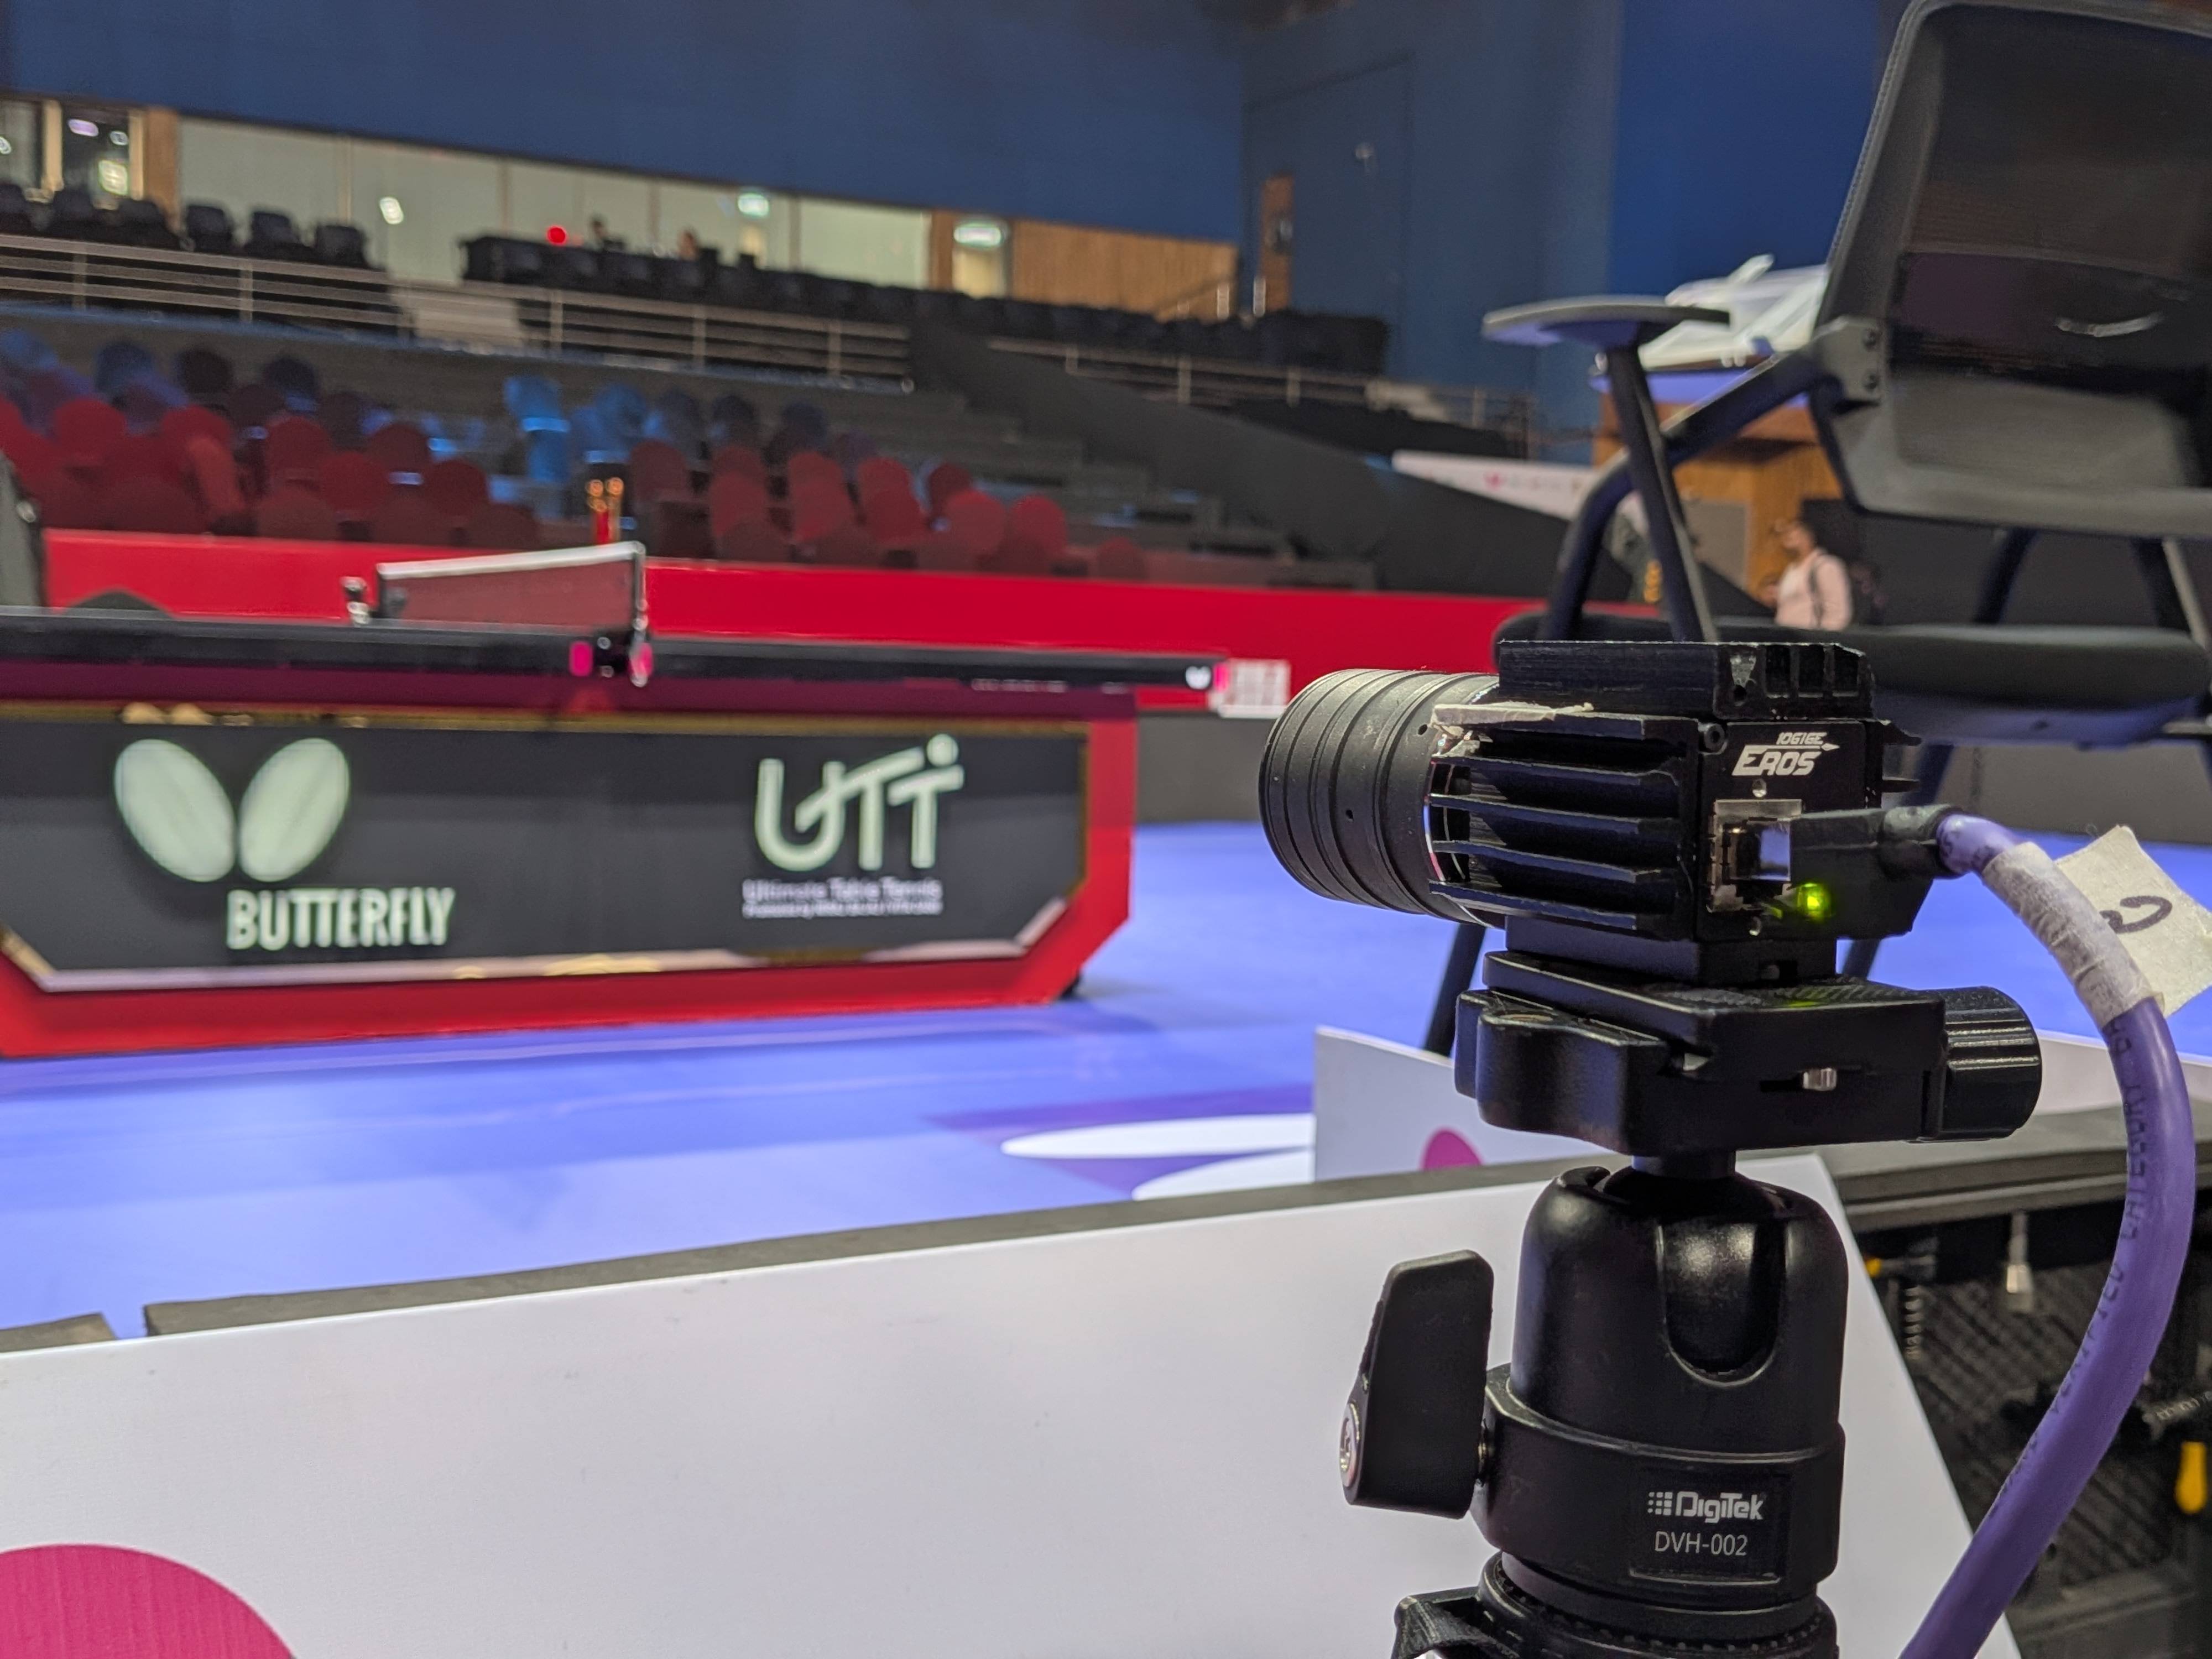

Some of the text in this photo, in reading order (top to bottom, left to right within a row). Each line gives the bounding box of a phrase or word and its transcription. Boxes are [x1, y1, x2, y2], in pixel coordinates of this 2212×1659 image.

[1731, 744, 1823, 776] EROS
[226, 886, 456, 951] BUTTERFLY
[1655, 1530, 1748, 1556] DVH-002
